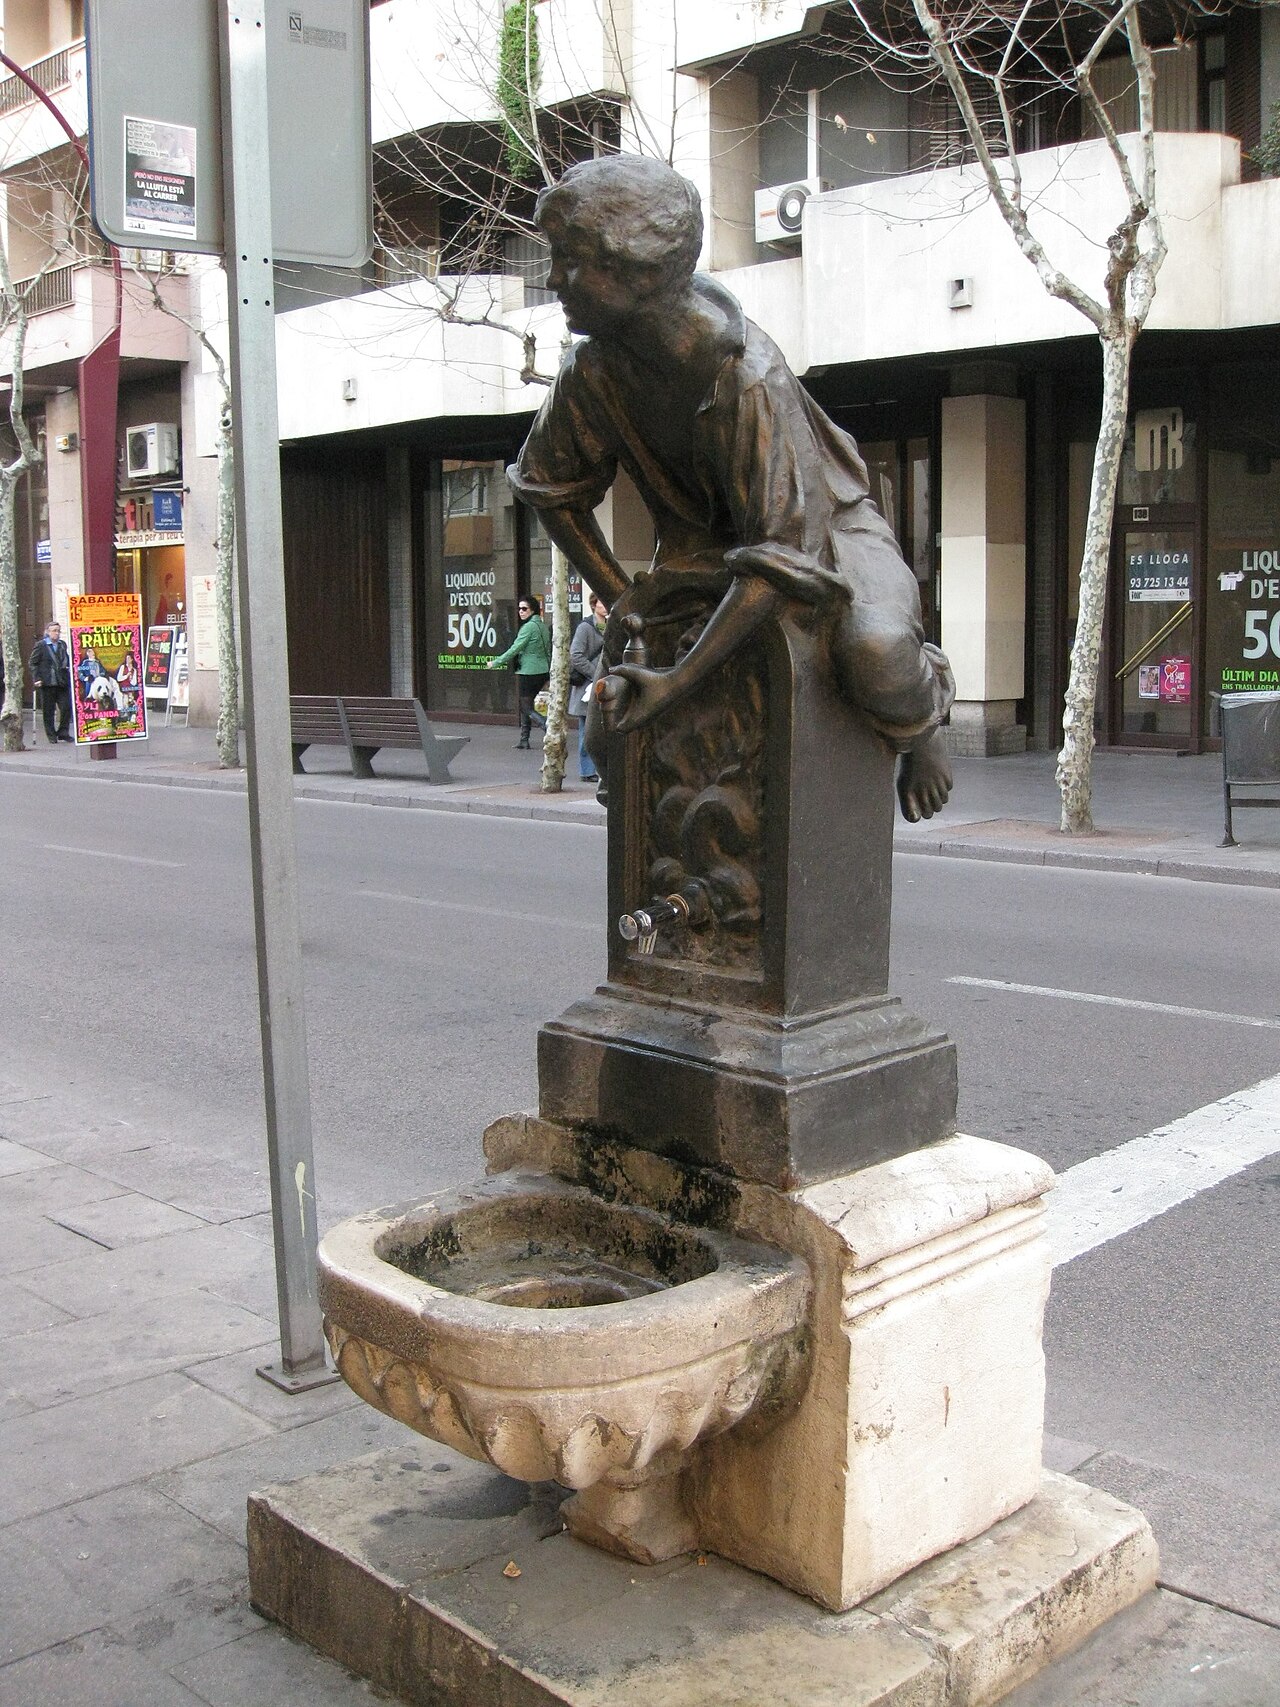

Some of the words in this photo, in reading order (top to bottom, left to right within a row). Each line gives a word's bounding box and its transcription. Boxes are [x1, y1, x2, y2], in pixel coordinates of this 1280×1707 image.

[137, 181, 145, 189] LA
[146, 182, 168, 192] LLUITA
[144, 190, 152, 198] AL
[153, 191, 178, 201] CARRER
[1130, 555, 1142, 565] ES
[1149, 553, 1189, 565] LLOGA
[445, 568, 496, 589] LIQUIDACIÓ
[1130, 578, 1141, 588] 93
[1143, 578, 1160, 588] 725
[1164, 577, 1174, 587] 13
[1177, 576, 1188, 587] 44
[70, 595, 139, 605] SABADELL
[450, 591, 492, 607] D'ESTOCS
[94, 625, 118, 633] CIRC
[447, 612, 497, 649] 50%
[82, 632, 132, 648] RALUY
[456, 655, 466, 663] DIA
[1222, 667, 1255, 682] ÚLTIM
[1259, 671, 1279, 682] DIA
[94, 710, 119, 719] PANDA
